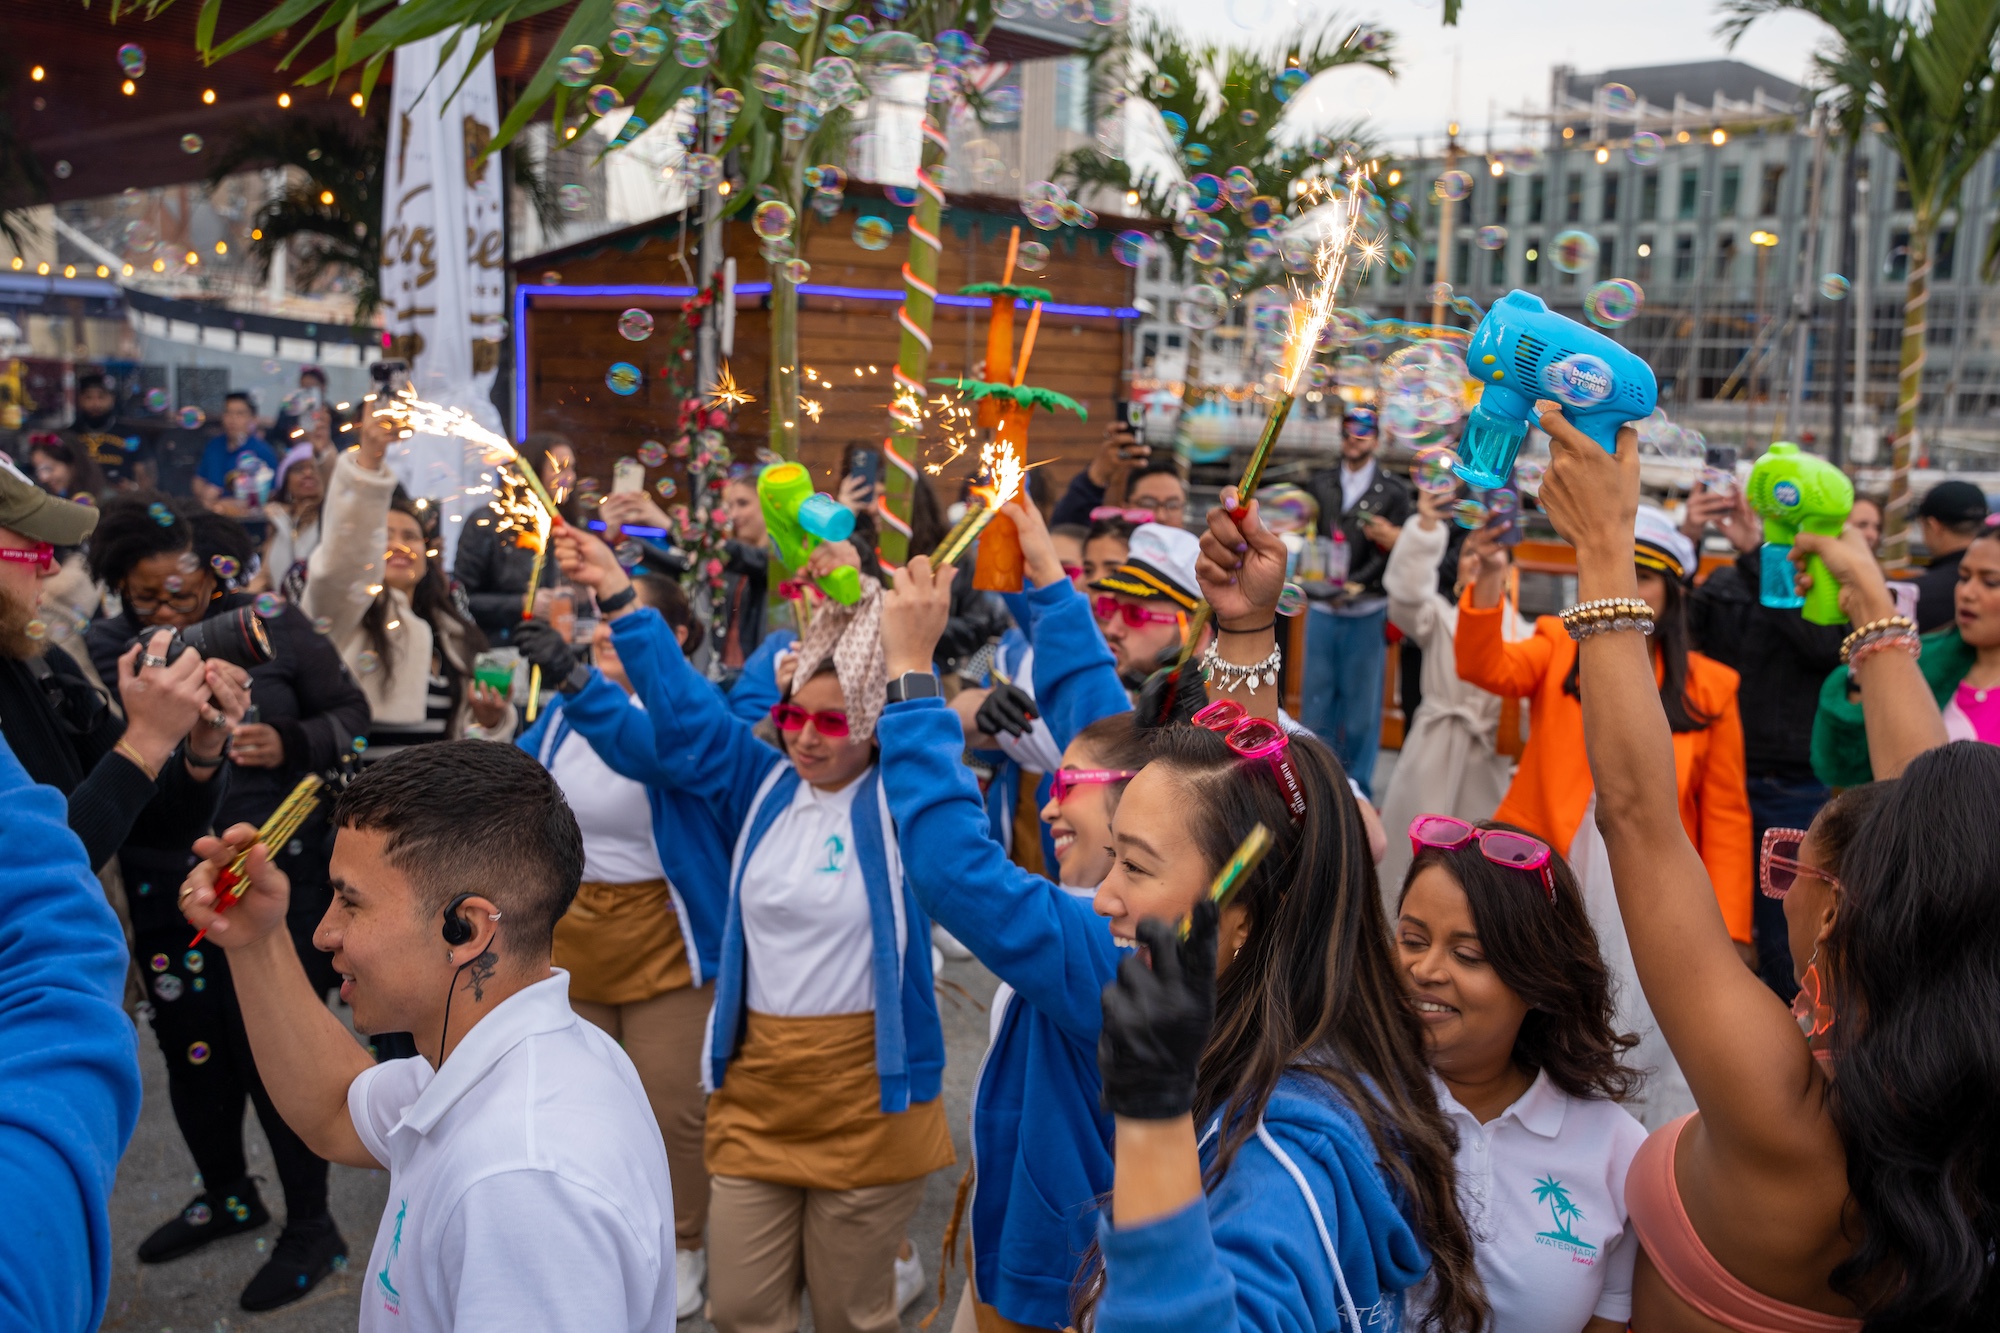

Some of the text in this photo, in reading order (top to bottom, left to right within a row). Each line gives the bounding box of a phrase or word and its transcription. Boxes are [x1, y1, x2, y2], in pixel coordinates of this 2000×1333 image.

[1570, 376, 1605, 394] STORM
[1572, 366, 1608, 386] bubble
[1534, 1235, 1598, 1259] WATERMARK
[1572, 1250, 1594, 1266] beach
